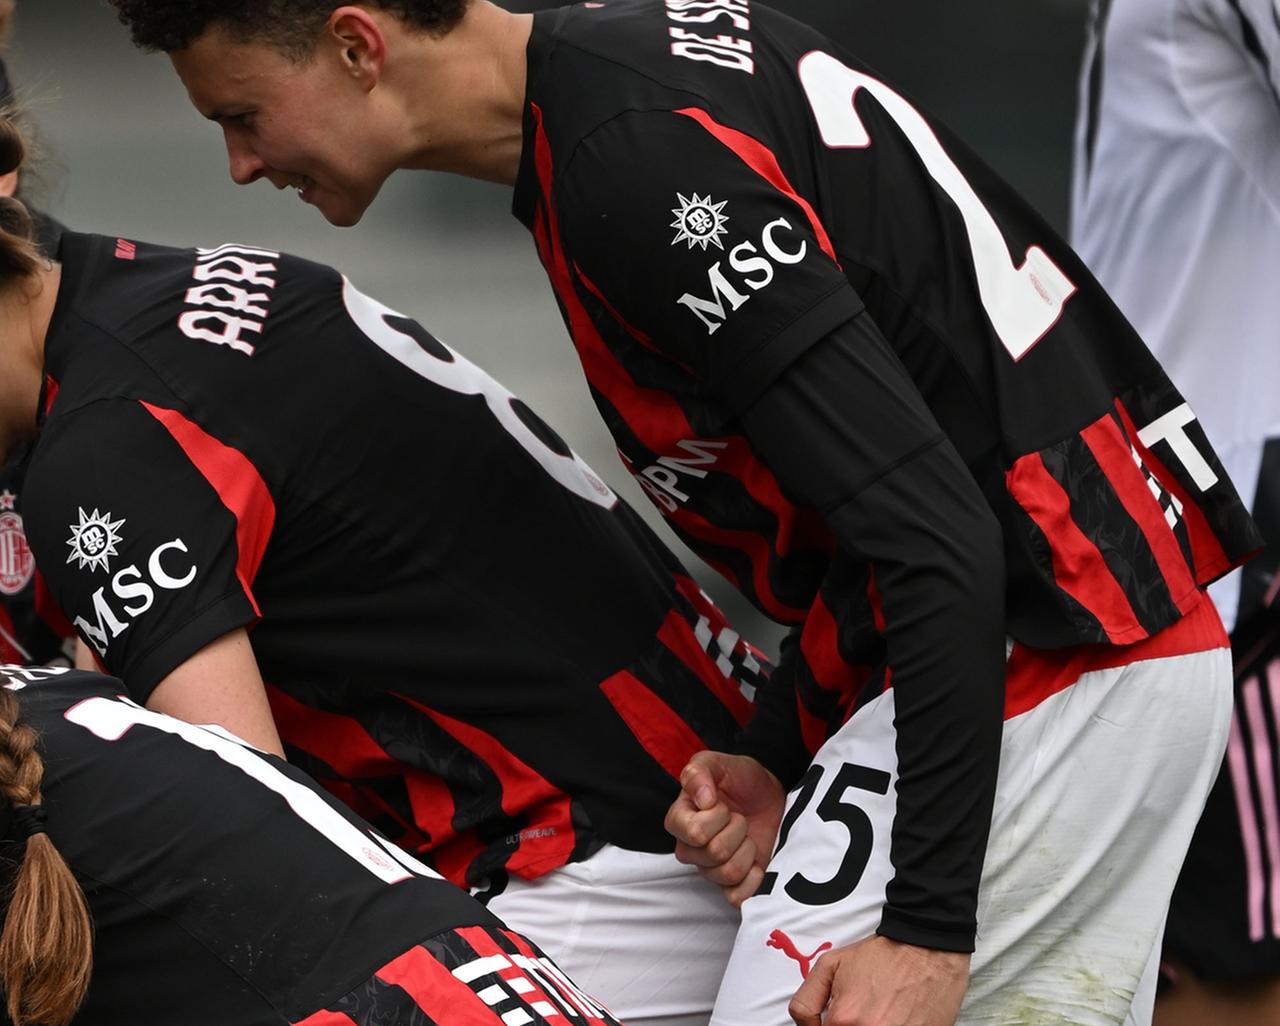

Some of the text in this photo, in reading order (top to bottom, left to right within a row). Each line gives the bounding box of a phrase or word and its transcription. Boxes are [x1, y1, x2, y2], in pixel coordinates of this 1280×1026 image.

[668, 27, 754, 75] DE
[676, 217, 807, 336] MSC
[73, 538, 198, 659] MSC
